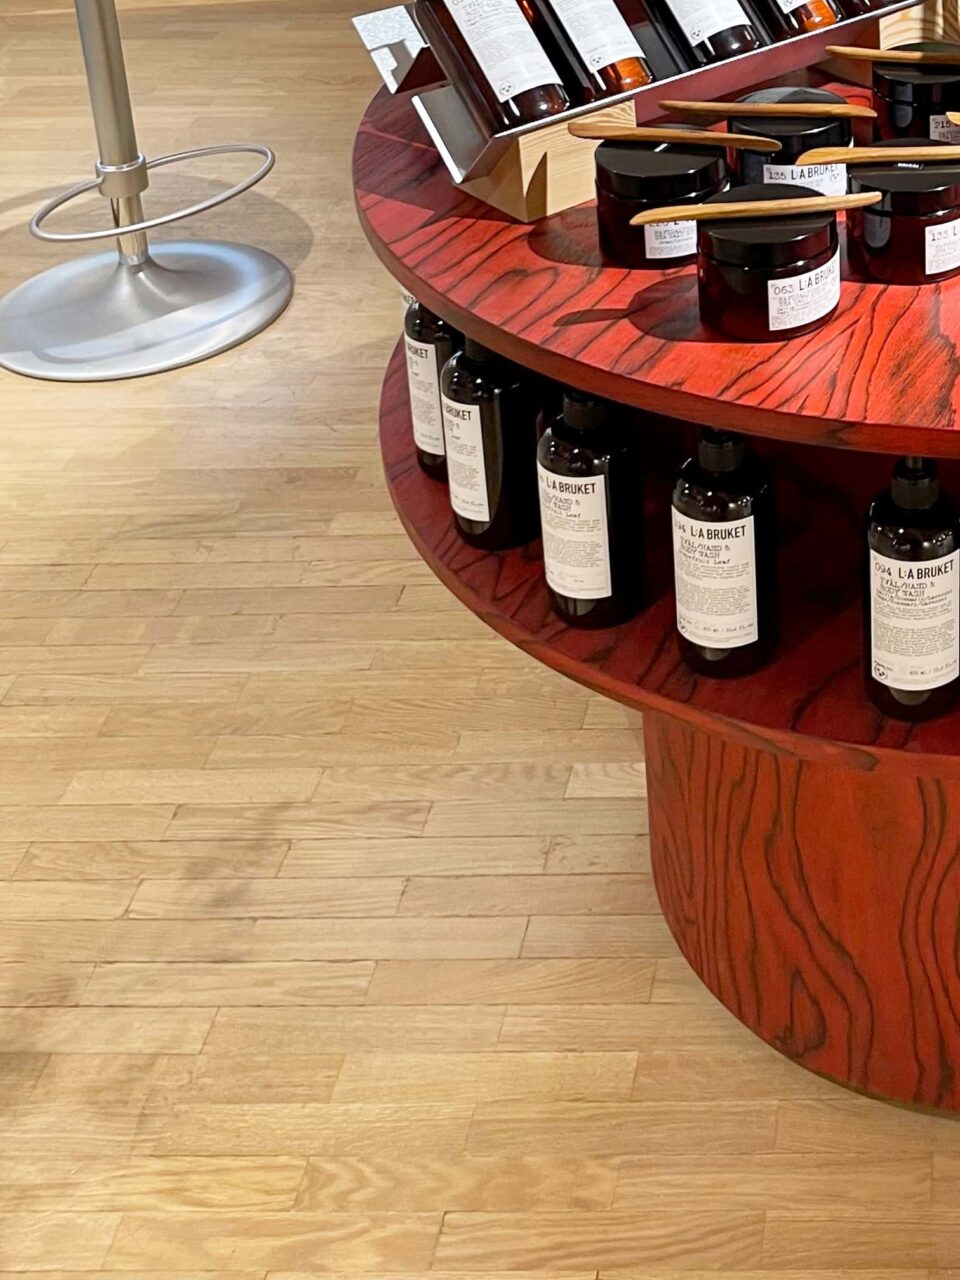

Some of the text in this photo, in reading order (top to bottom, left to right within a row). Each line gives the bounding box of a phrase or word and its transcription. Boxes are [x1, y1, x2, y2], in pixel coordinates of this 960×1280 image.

[558, 481, 597, 496] BRUKET
[705, 524, 746, 540] BRUKET
[874, 559, 955, 580] 094 L:A BRUKET
